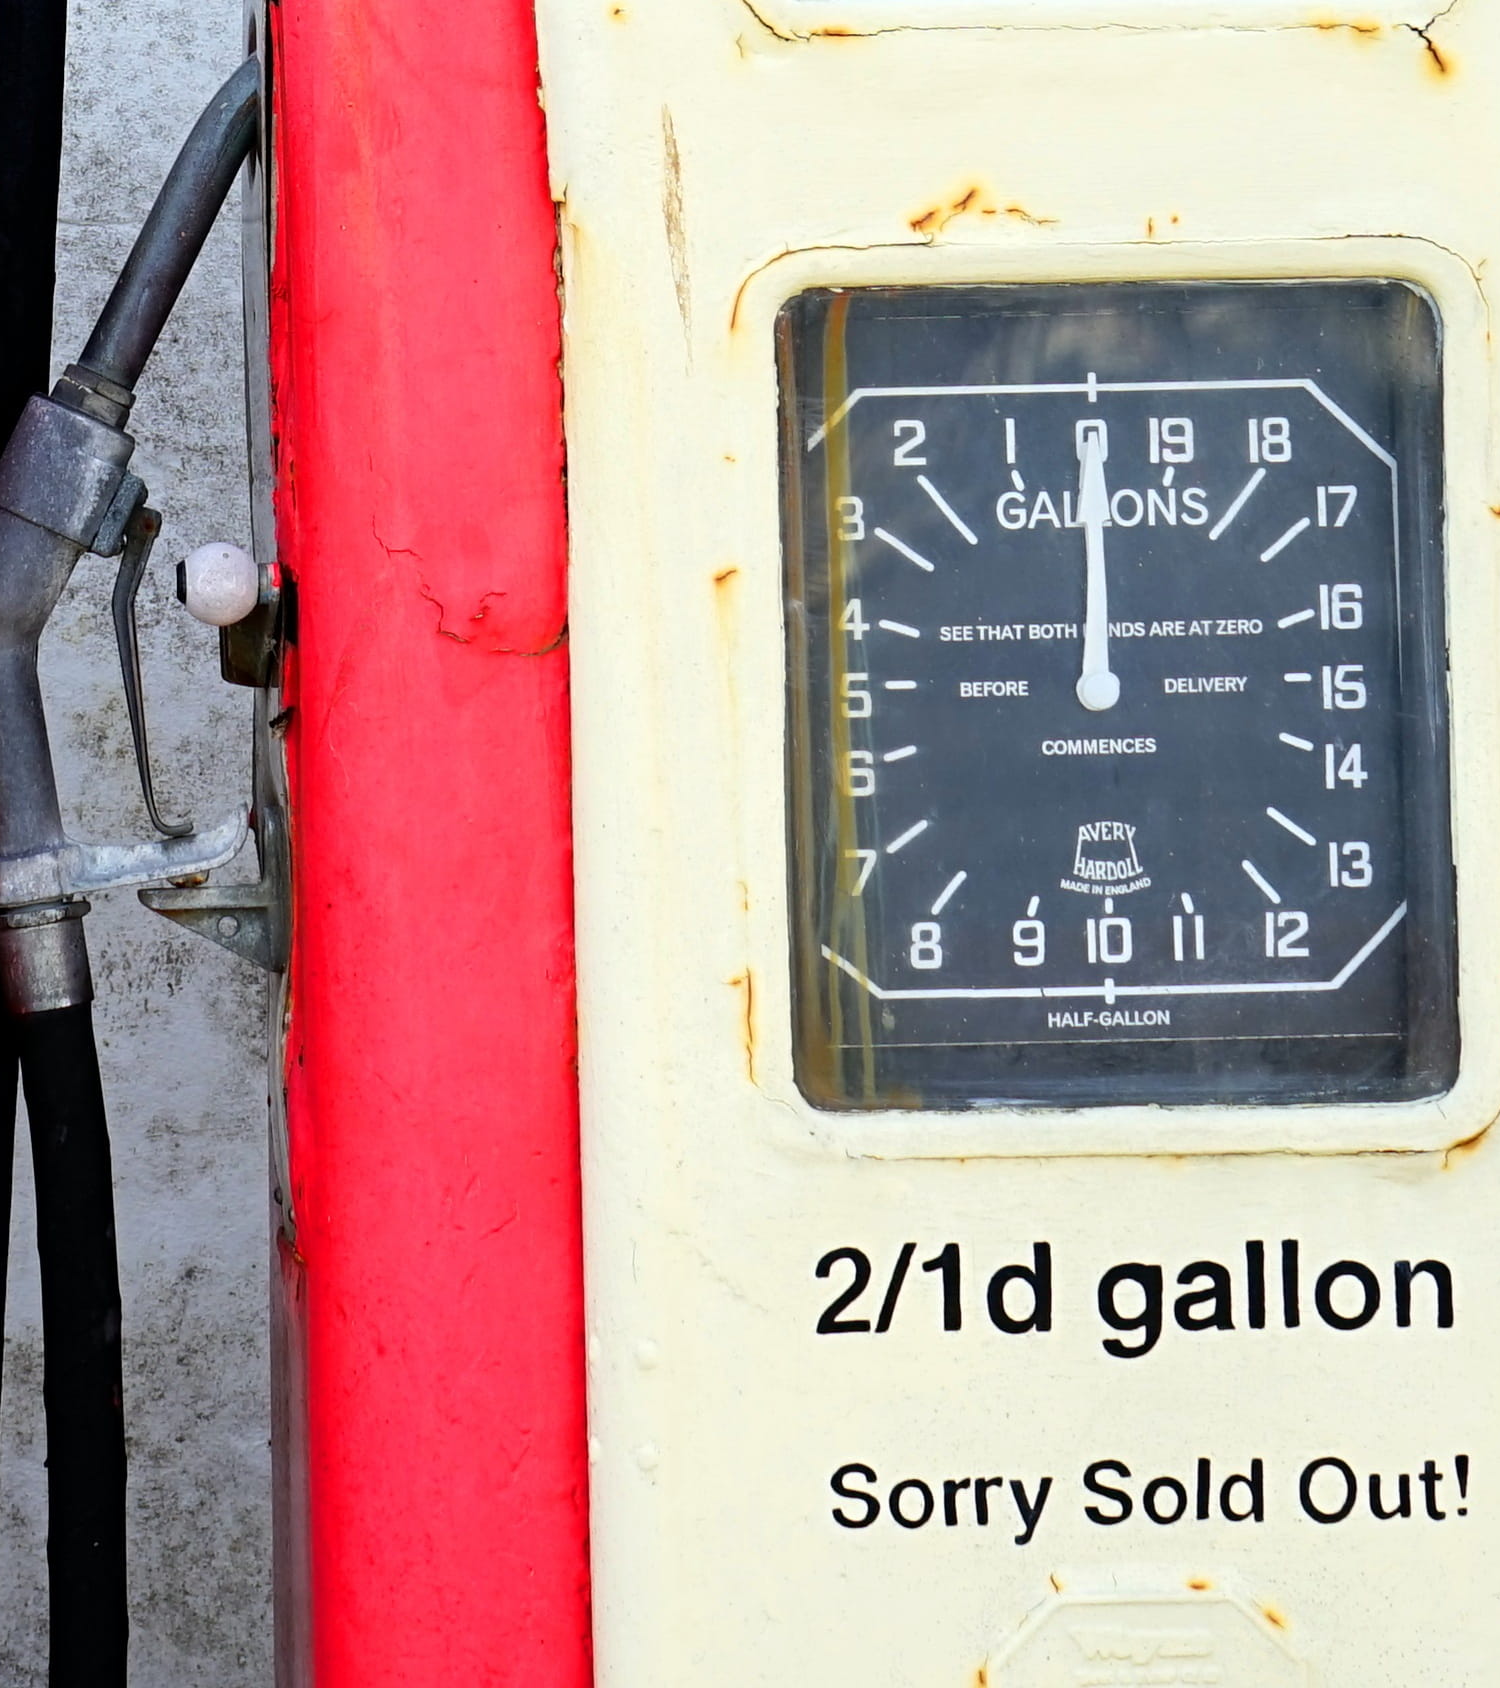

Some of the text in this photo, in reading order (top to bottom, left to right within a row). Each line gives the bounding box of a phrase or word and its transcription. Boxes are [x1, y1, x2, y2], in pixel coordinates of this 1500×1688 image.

[893, 417, 1292, 467] 2 1 0 19 18
[836, 496, 865, 542] 3
[996, 487, 1209, 530] GALONS
[1317, 485, 1358, 528] 17
[838, 598, 870, 641] 4
[940, 619, 1263, 642] SEE THAT BOTH NDS ARE AT ZERO
[1318, 585, 1363, 632] 16
[840, 673, 872, 719] 5
[960, 681, 1029, 697] BEFORE
[1164, 676, 1248, 694] DELIVERY
[1321, 664, 1367, 711] 15
[1041, 737, 1157, 756] COMMENCES
[1323, 743, 1369, 790] 14
[843, 750, 876, 797] 6
[1079, 821, 1136, 842] AVERY
[844, 849, 877, 897] 7
[1060, 877, 1151, 896] MADE IN ENGLAND
[1073, 857, 1144, 881] HARDOLL
[1328, 841, 1373, 889] 13
[910, 910, 1310, 970] 8 9 10 11 12
[1046, 1009, 1171, 1029] HALF-GALLON
[814, 1239, 1454, 1358] 2/1d gallon
[831, 1455, 1471, 1544] Sorry Sold Out!
